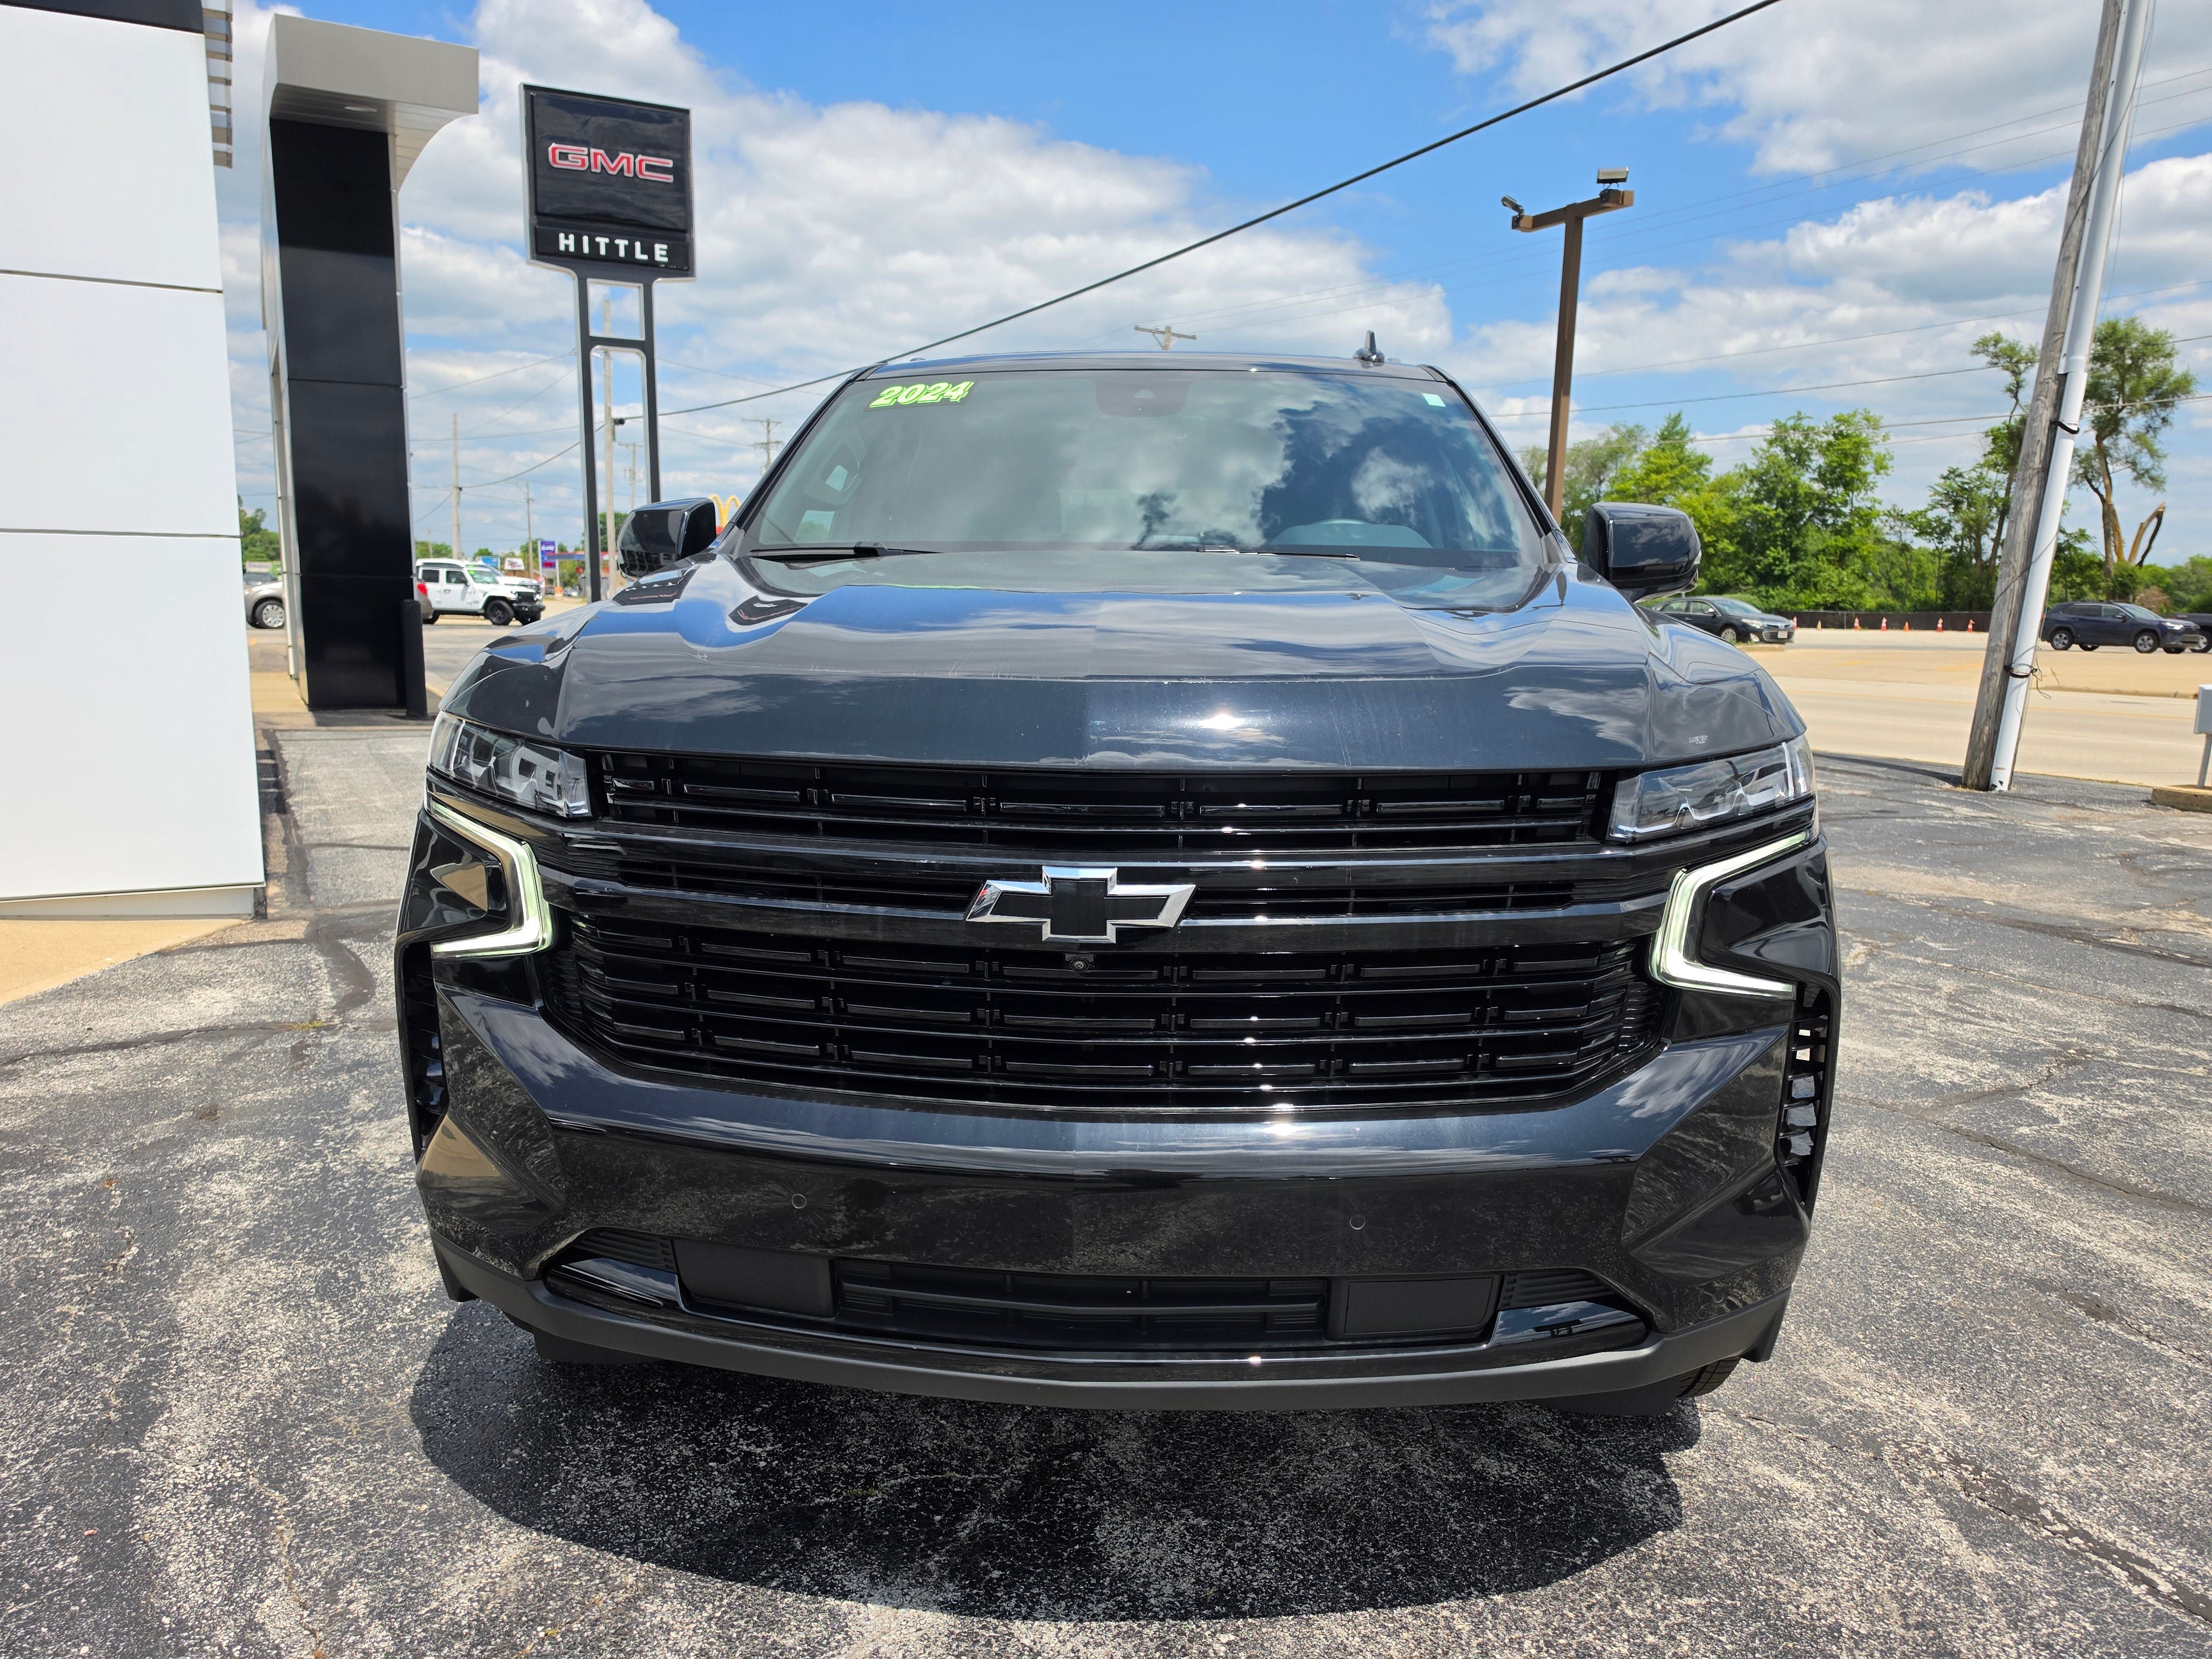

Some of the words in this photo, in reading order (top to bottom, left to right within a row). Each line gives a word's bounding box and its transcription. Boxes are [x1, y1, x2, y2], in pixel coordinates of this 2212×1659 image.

[548, 142, 674, 183] GMC
[559, 232, 669, 262] HITTLE
[869, 381, 974, 408] 2024
